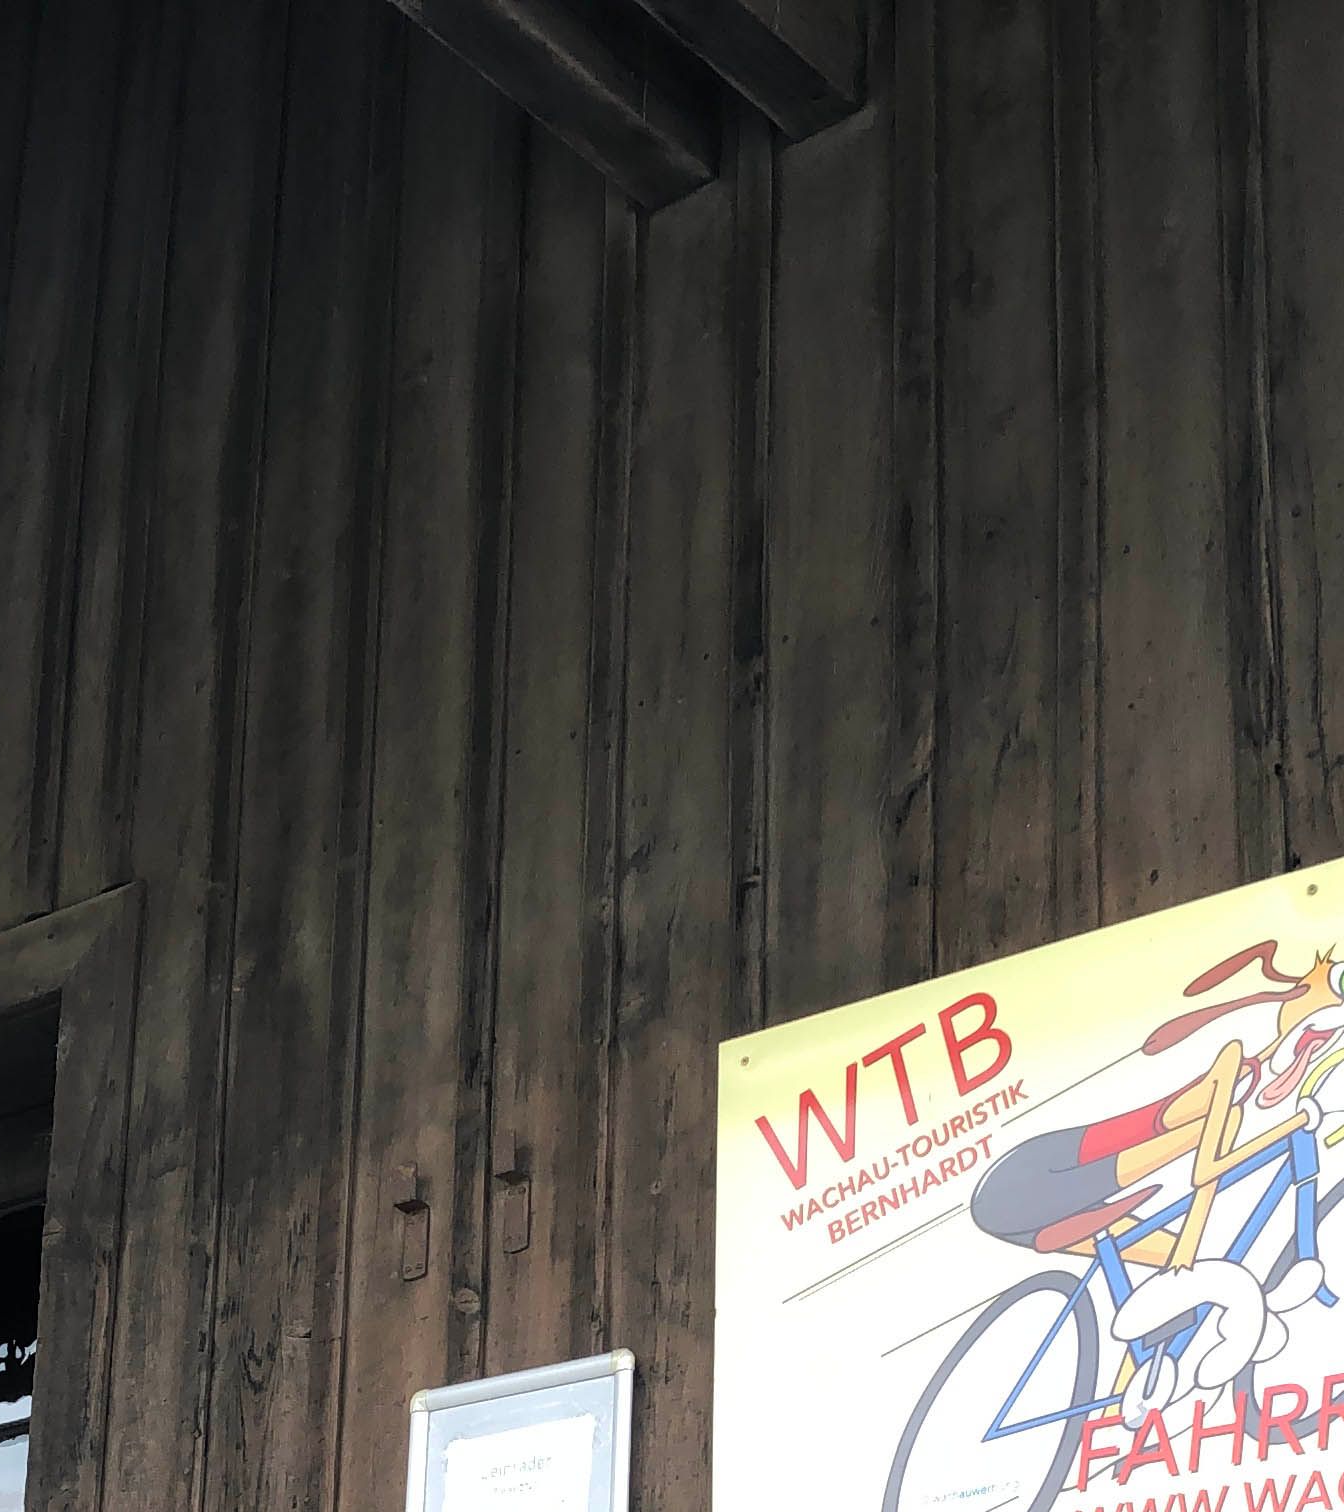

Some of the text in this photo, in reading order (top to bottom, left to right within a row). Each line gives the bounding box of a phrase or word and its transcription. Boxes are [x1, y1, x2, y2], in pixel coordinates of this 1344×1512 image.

[754, 991, 1013, 1191] WTB
[780, 1078, 1030, 1232] WACHAU-TOURISTIK
[827, 1133, 994, 1245] BERNHARDT
